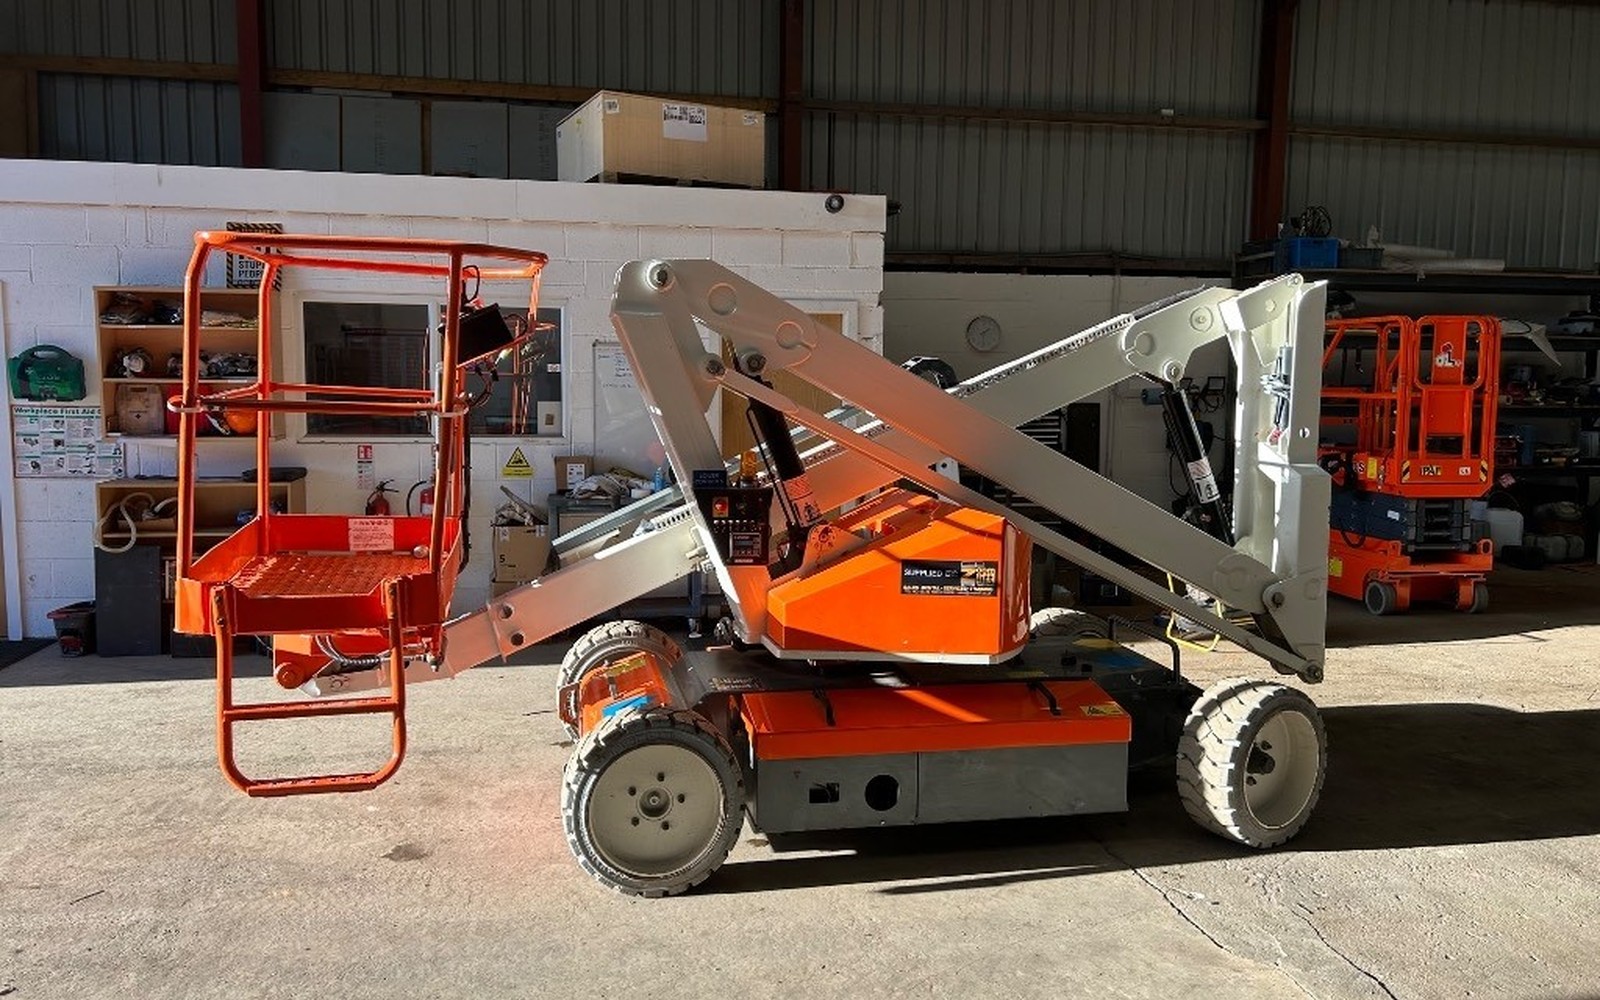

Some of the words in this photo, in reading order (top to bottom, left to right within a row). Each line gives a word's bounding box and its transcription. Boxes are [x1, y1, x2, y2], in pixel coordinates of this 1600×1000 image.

[238, 261, 266, 269] STUPI
[14, 407, 57, 415] Workplace
[903, 568, 943, 577] SUPPLIED
